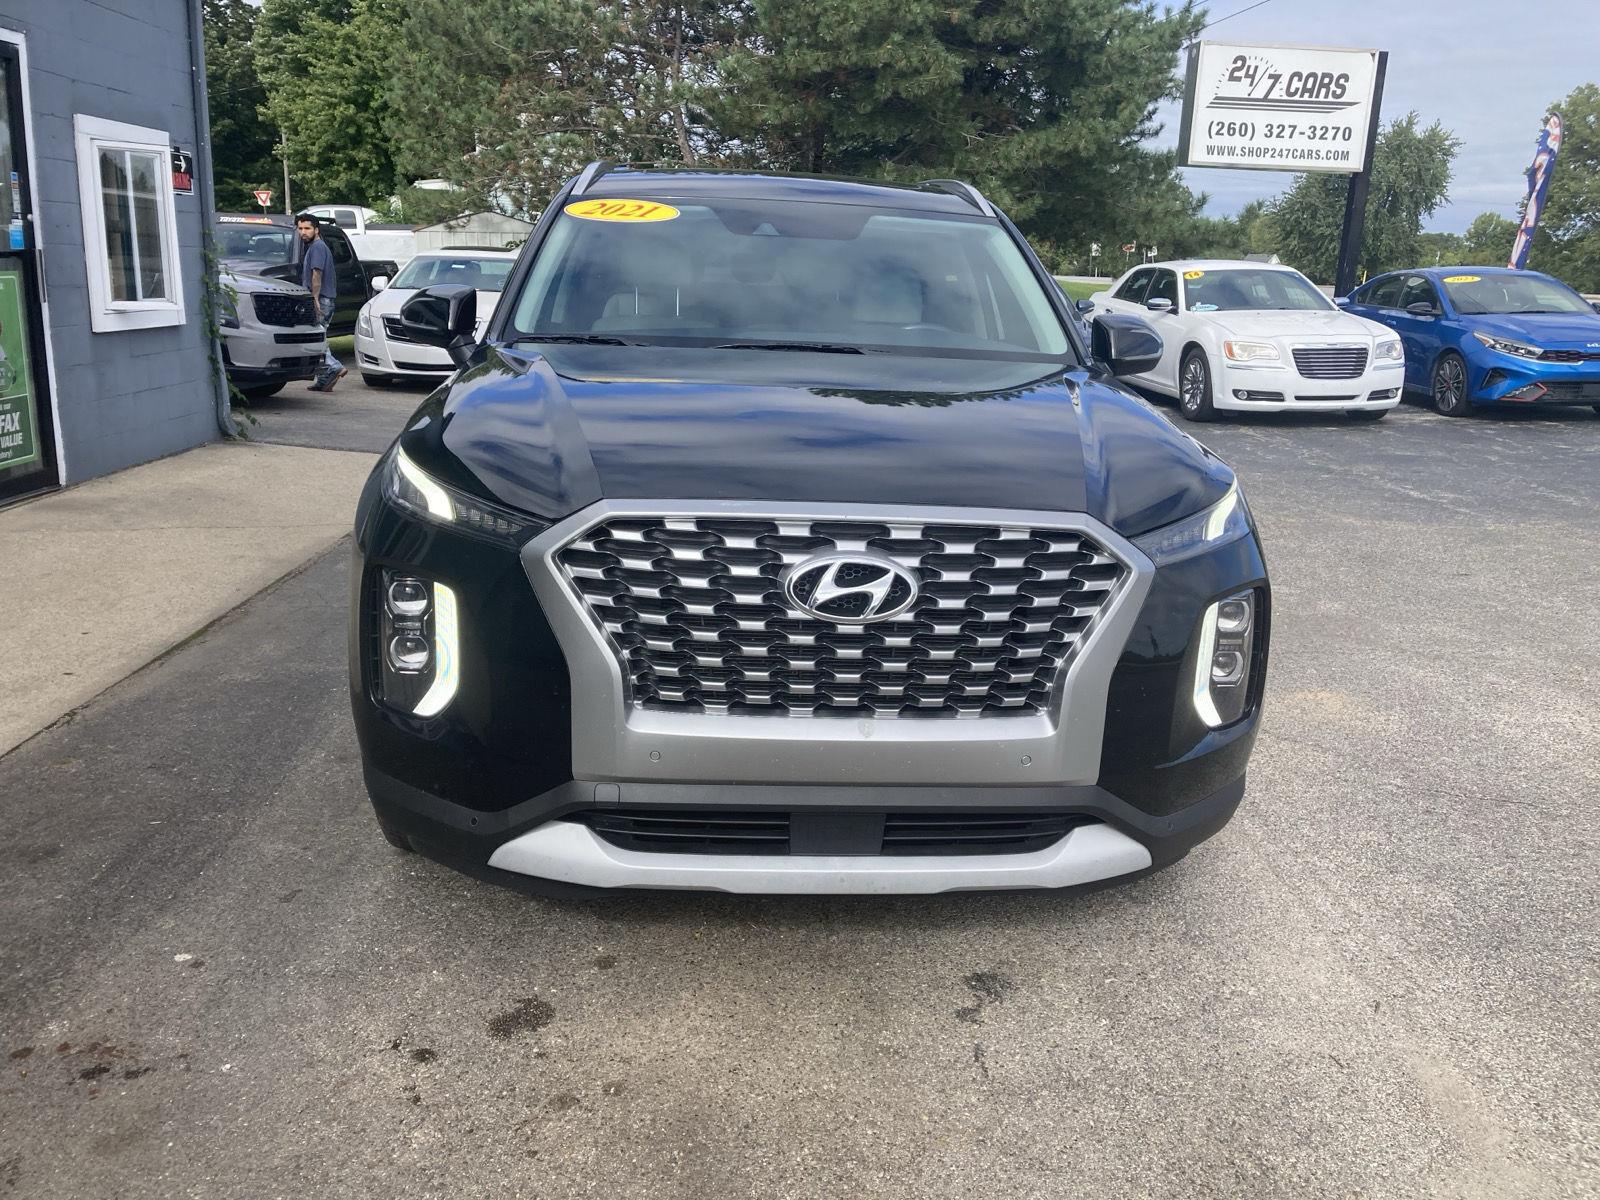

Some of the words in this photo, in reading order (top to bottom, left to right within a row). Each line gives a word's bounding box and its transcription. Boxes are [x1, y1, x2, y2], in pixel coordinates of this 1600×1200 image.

[1228, 54, 1283, 100] 24/7
[1285, 71, 1350, 100] CARS
[1207, 120, 1256, 141] (260)
[1264, 123, 1353, 142] 327-3270
[1206, 144, 1350, 162] WWW.SHOP247CARS.COM
[581, 202, 661, 218] 2021
[0, 432, 23, 449] VALUE
